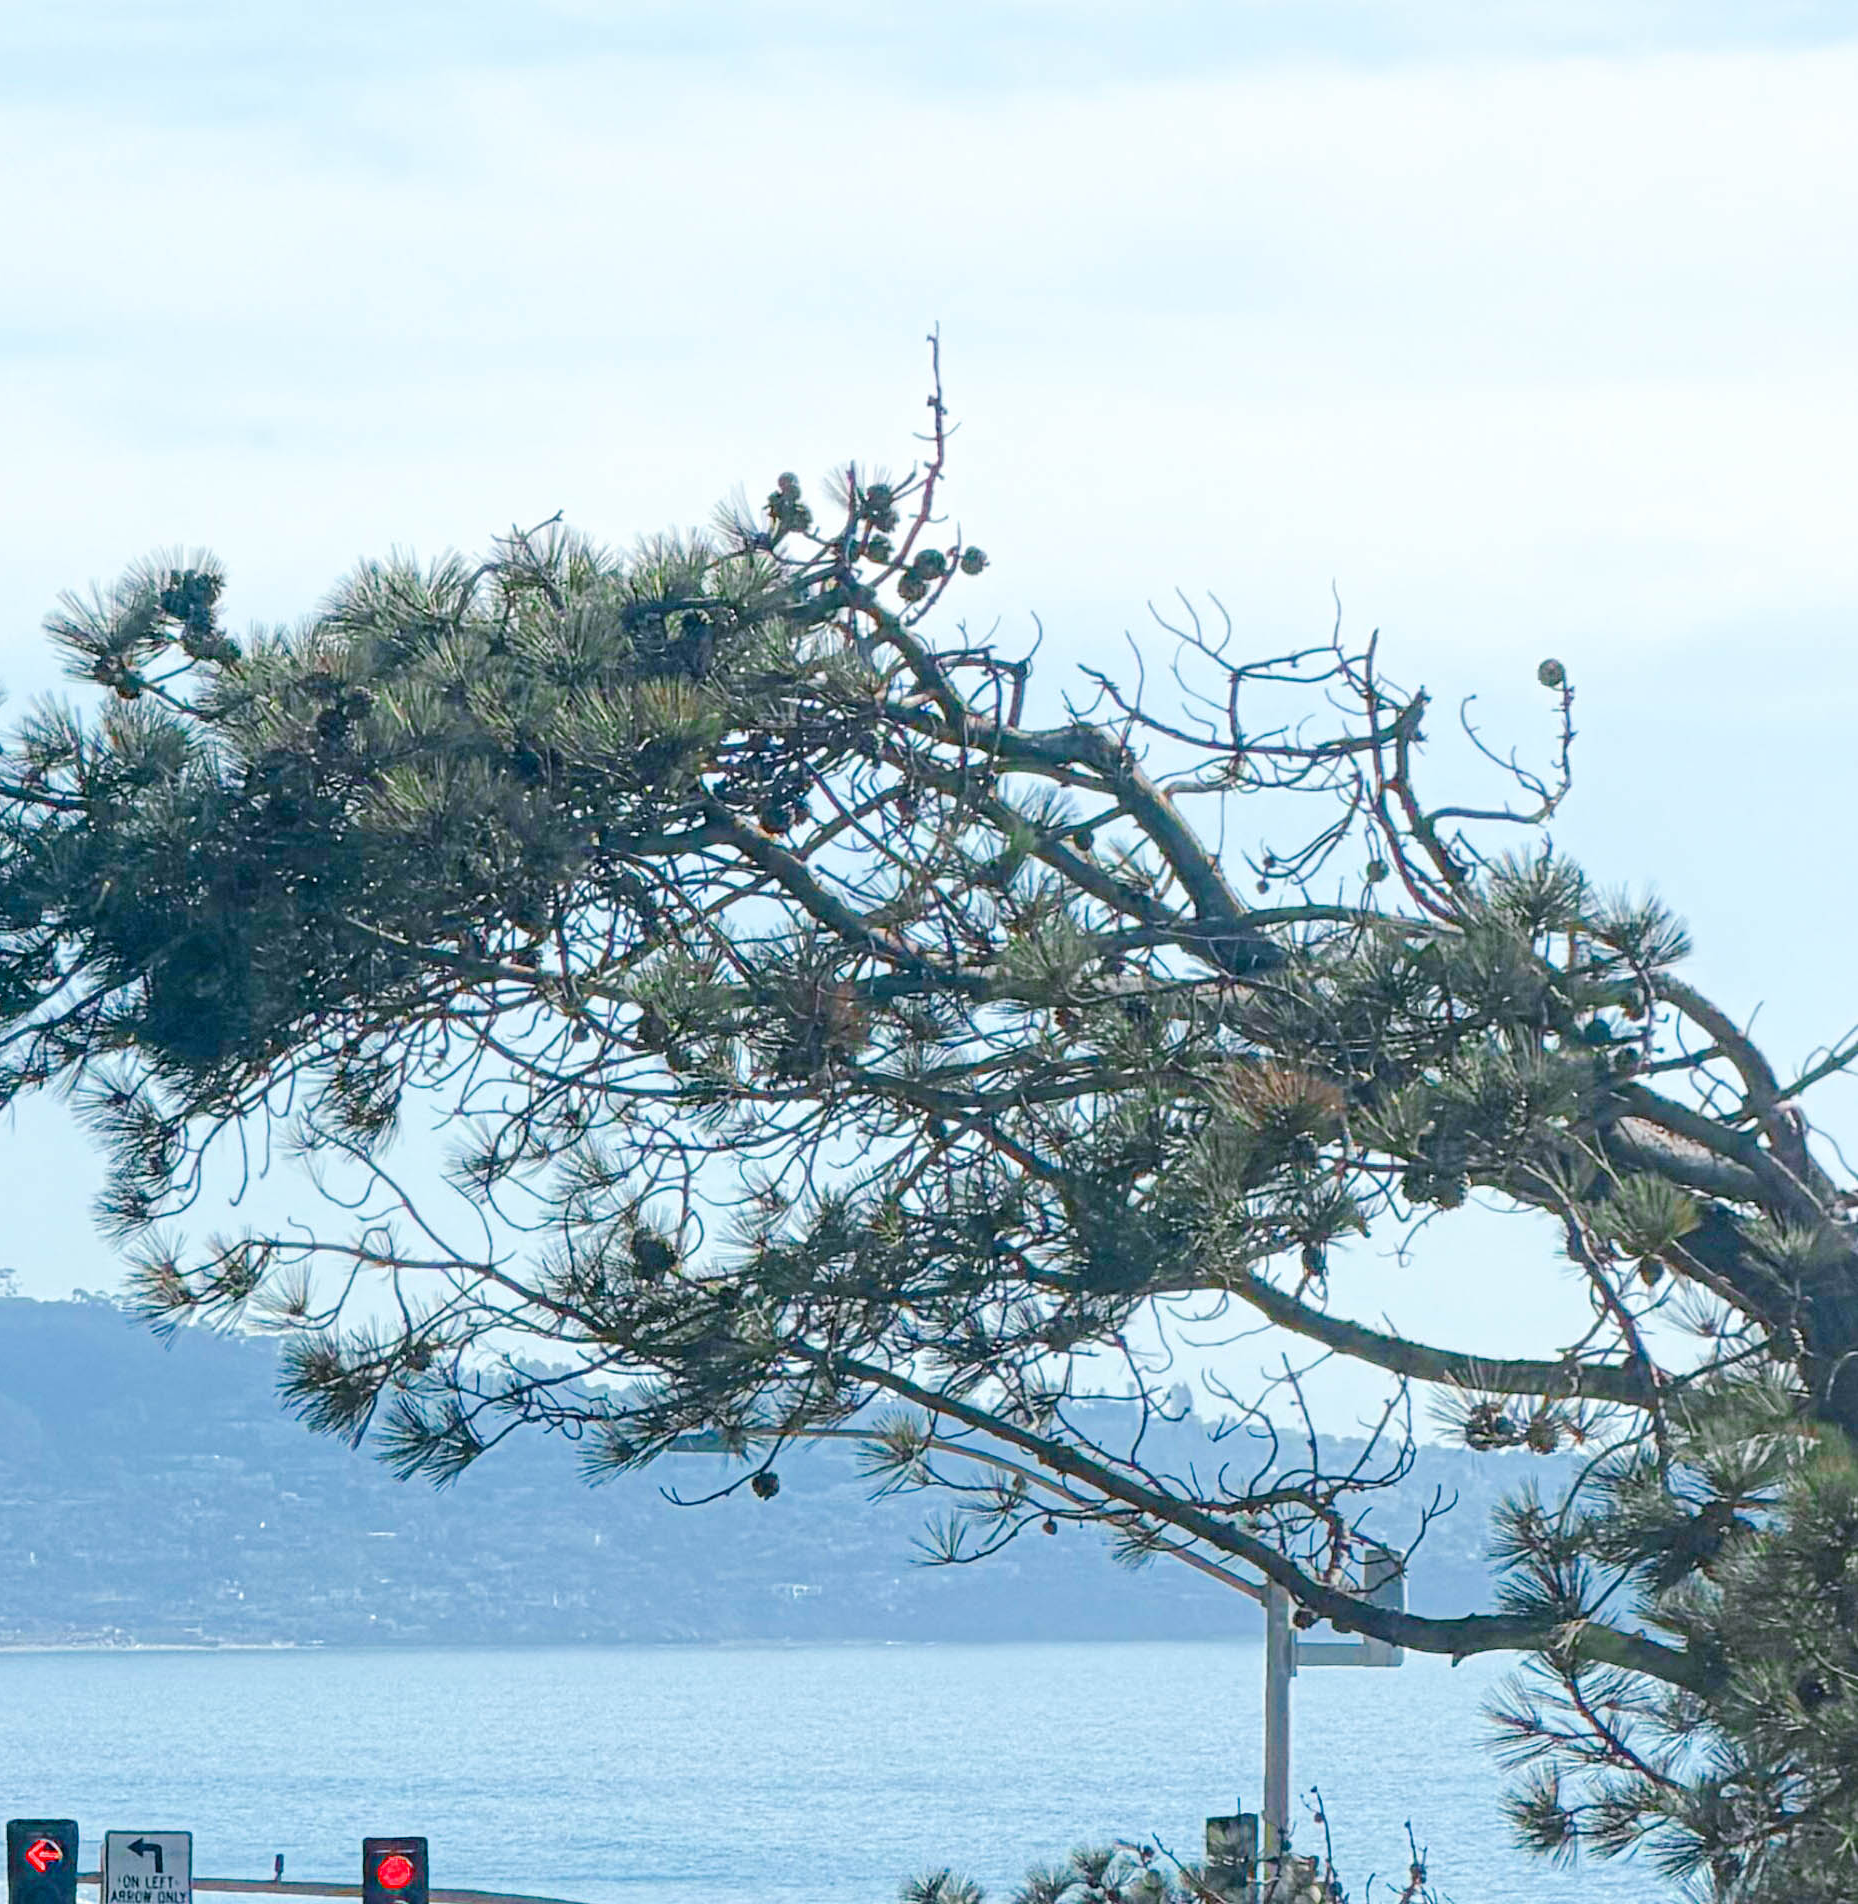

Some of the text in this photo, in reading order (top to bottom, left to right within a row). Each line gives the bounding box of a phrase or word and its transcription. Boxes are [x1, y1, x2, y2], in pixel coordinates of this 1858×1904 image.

[123, 1874, 174, 1889] ON LEFT
[110, 1890, 186, 1904] ARROW ONLY
